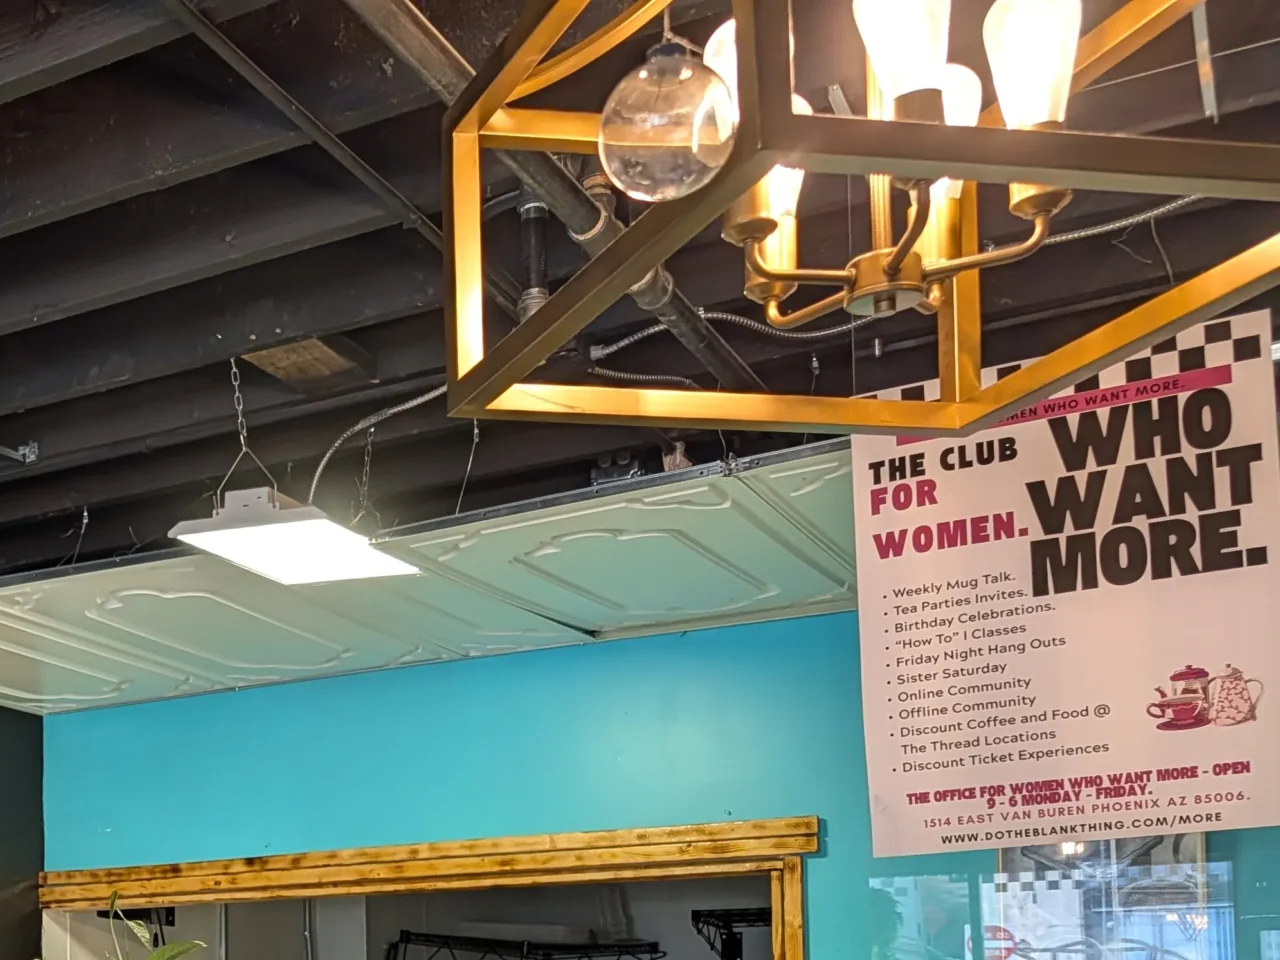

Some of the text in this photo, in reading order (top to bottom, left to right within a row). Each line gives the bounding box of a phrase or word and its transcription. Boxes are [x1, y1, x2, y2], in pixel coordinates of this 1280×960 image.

[1043, 400, 1078, 414] WHO
[1084, 388, 1131, 407] WANT
[1134, 379, 1186, 396] MORE.
[1046, 387, 1232, 473] WHO
[868, 436, 1018, 485] THE CLUB
[870, 478, 938, 516] FOR
[1025, 442, 1263, 536] WANT
[872, 511, 1029, 560] WOMEN.
[1030, 508, 1268, 598] MORE.
[892, 571, 1016, 599] Weekly Mug Talk.
[893, 588, 1028, 617] Tea Parties Invites.
[894, 603, 1056, 634] Birthday Celebrations.
[971, 624, 1027, 640] Classes
[896, 636, 1066, 668] Friday Night Hang Outs
[896, 662, 1008, 685] Sister Saturday
[897, 676, 1032, 702] Online Community
[898, 695, 1036, 720] Offline Community
[900, 704, 1111, 738] Discount Coffee and Food @
[900, 729, 1057, 755] The Thread Locations
[902, 743, 1110, 773] Discount Ticket Experiences
[906, 791, 931, 805] THE
[933, 787, 977, 802] OFFICE
[979, 784, 1006, 798] FOR
[1009, 779, 1065, 795] WOMEN
[1067, 775, 1103, 789] WHO
[1107, 770, 1153, 786] WANT
[1156, 766, 1199, 782] MORE
[1212, 761, 1251, 776] OPEN
[986, 798, 996, 809] 9
[1009, 796, 1018, 807] 6
[1021, 790, 1082, 806] MONDAY
[1095, 783, 1153, 800] FRIDAY.
[923, 791, 1251, 829] 1514 EAST VAN BUREN PHOENIX AZ 85006.
[941, 812, 1222, 844] WWW.DOTHEBLANKTHING.COM/MORE
